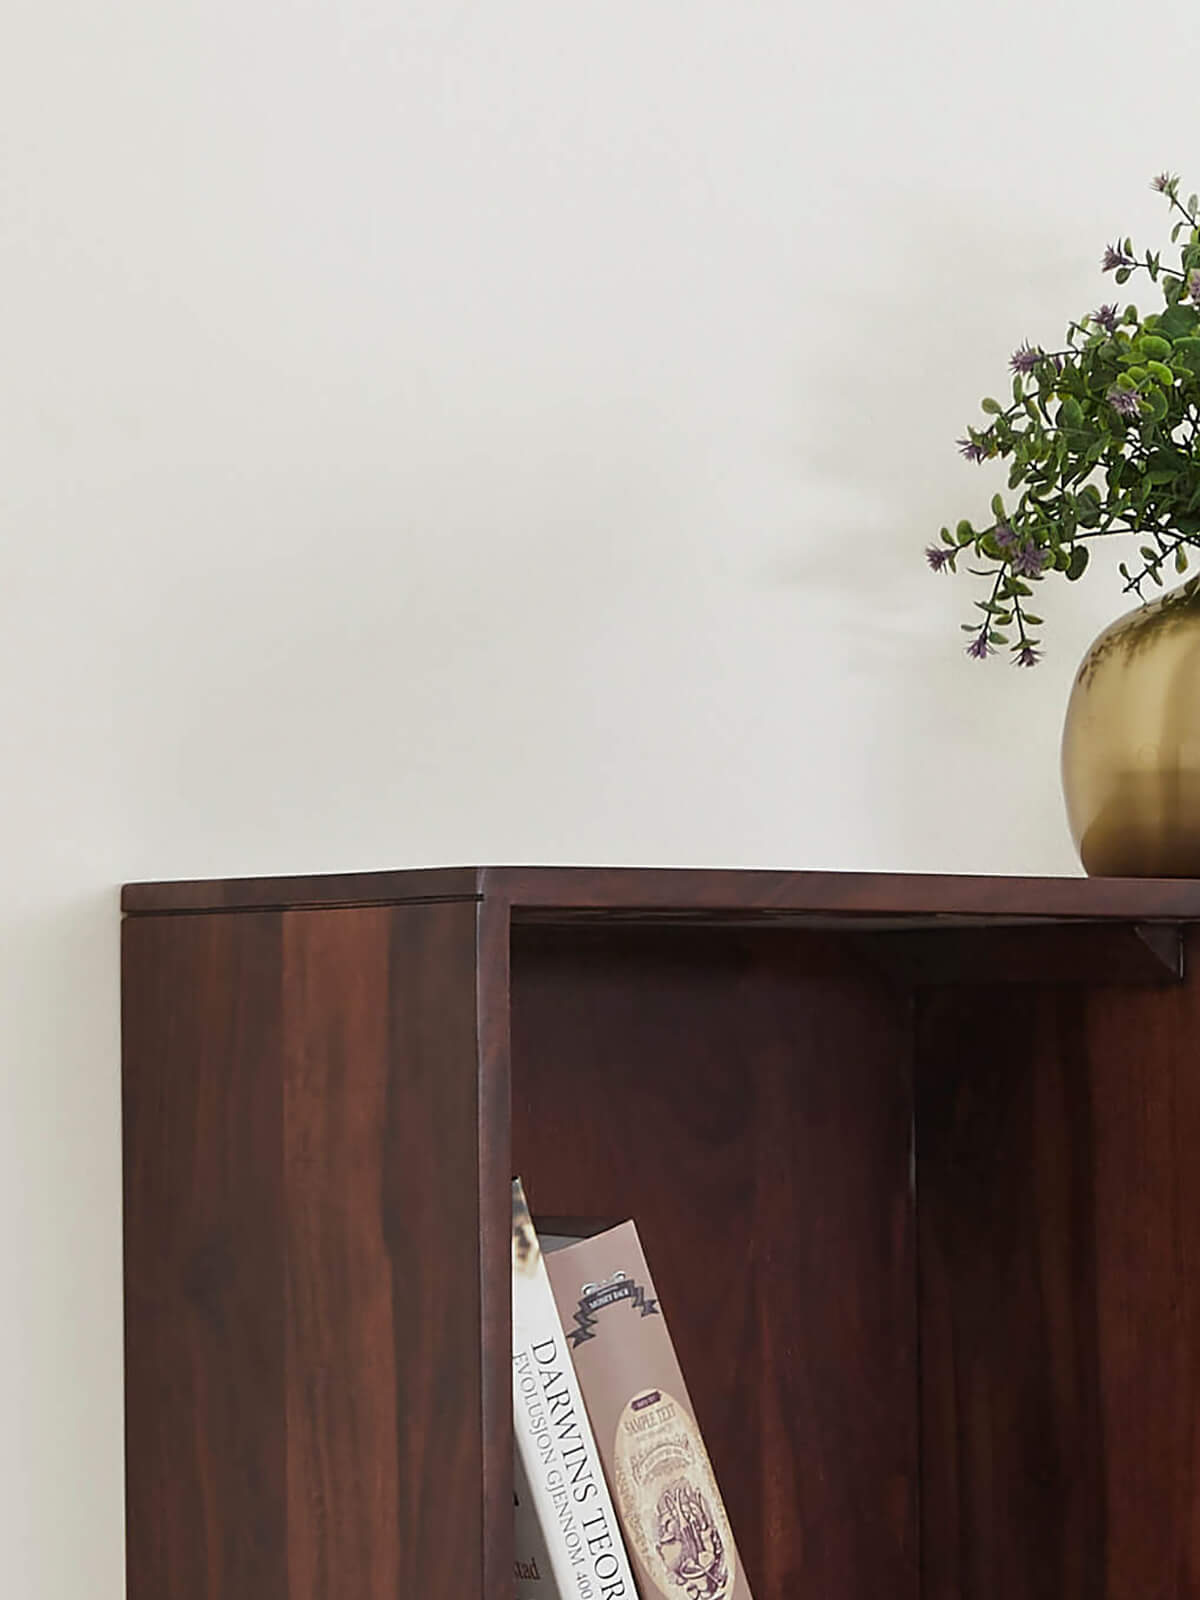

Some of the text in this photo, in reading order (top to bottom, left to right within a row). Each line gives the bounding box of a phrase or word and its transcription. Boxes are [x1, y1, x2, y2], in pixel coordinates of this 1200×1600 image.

[512, 1352, 557, 1465] EVOLUSJON
[544, 1470, 585, 1566] GJENNOM
[530, 1336, 598, 1503] DARWINS
